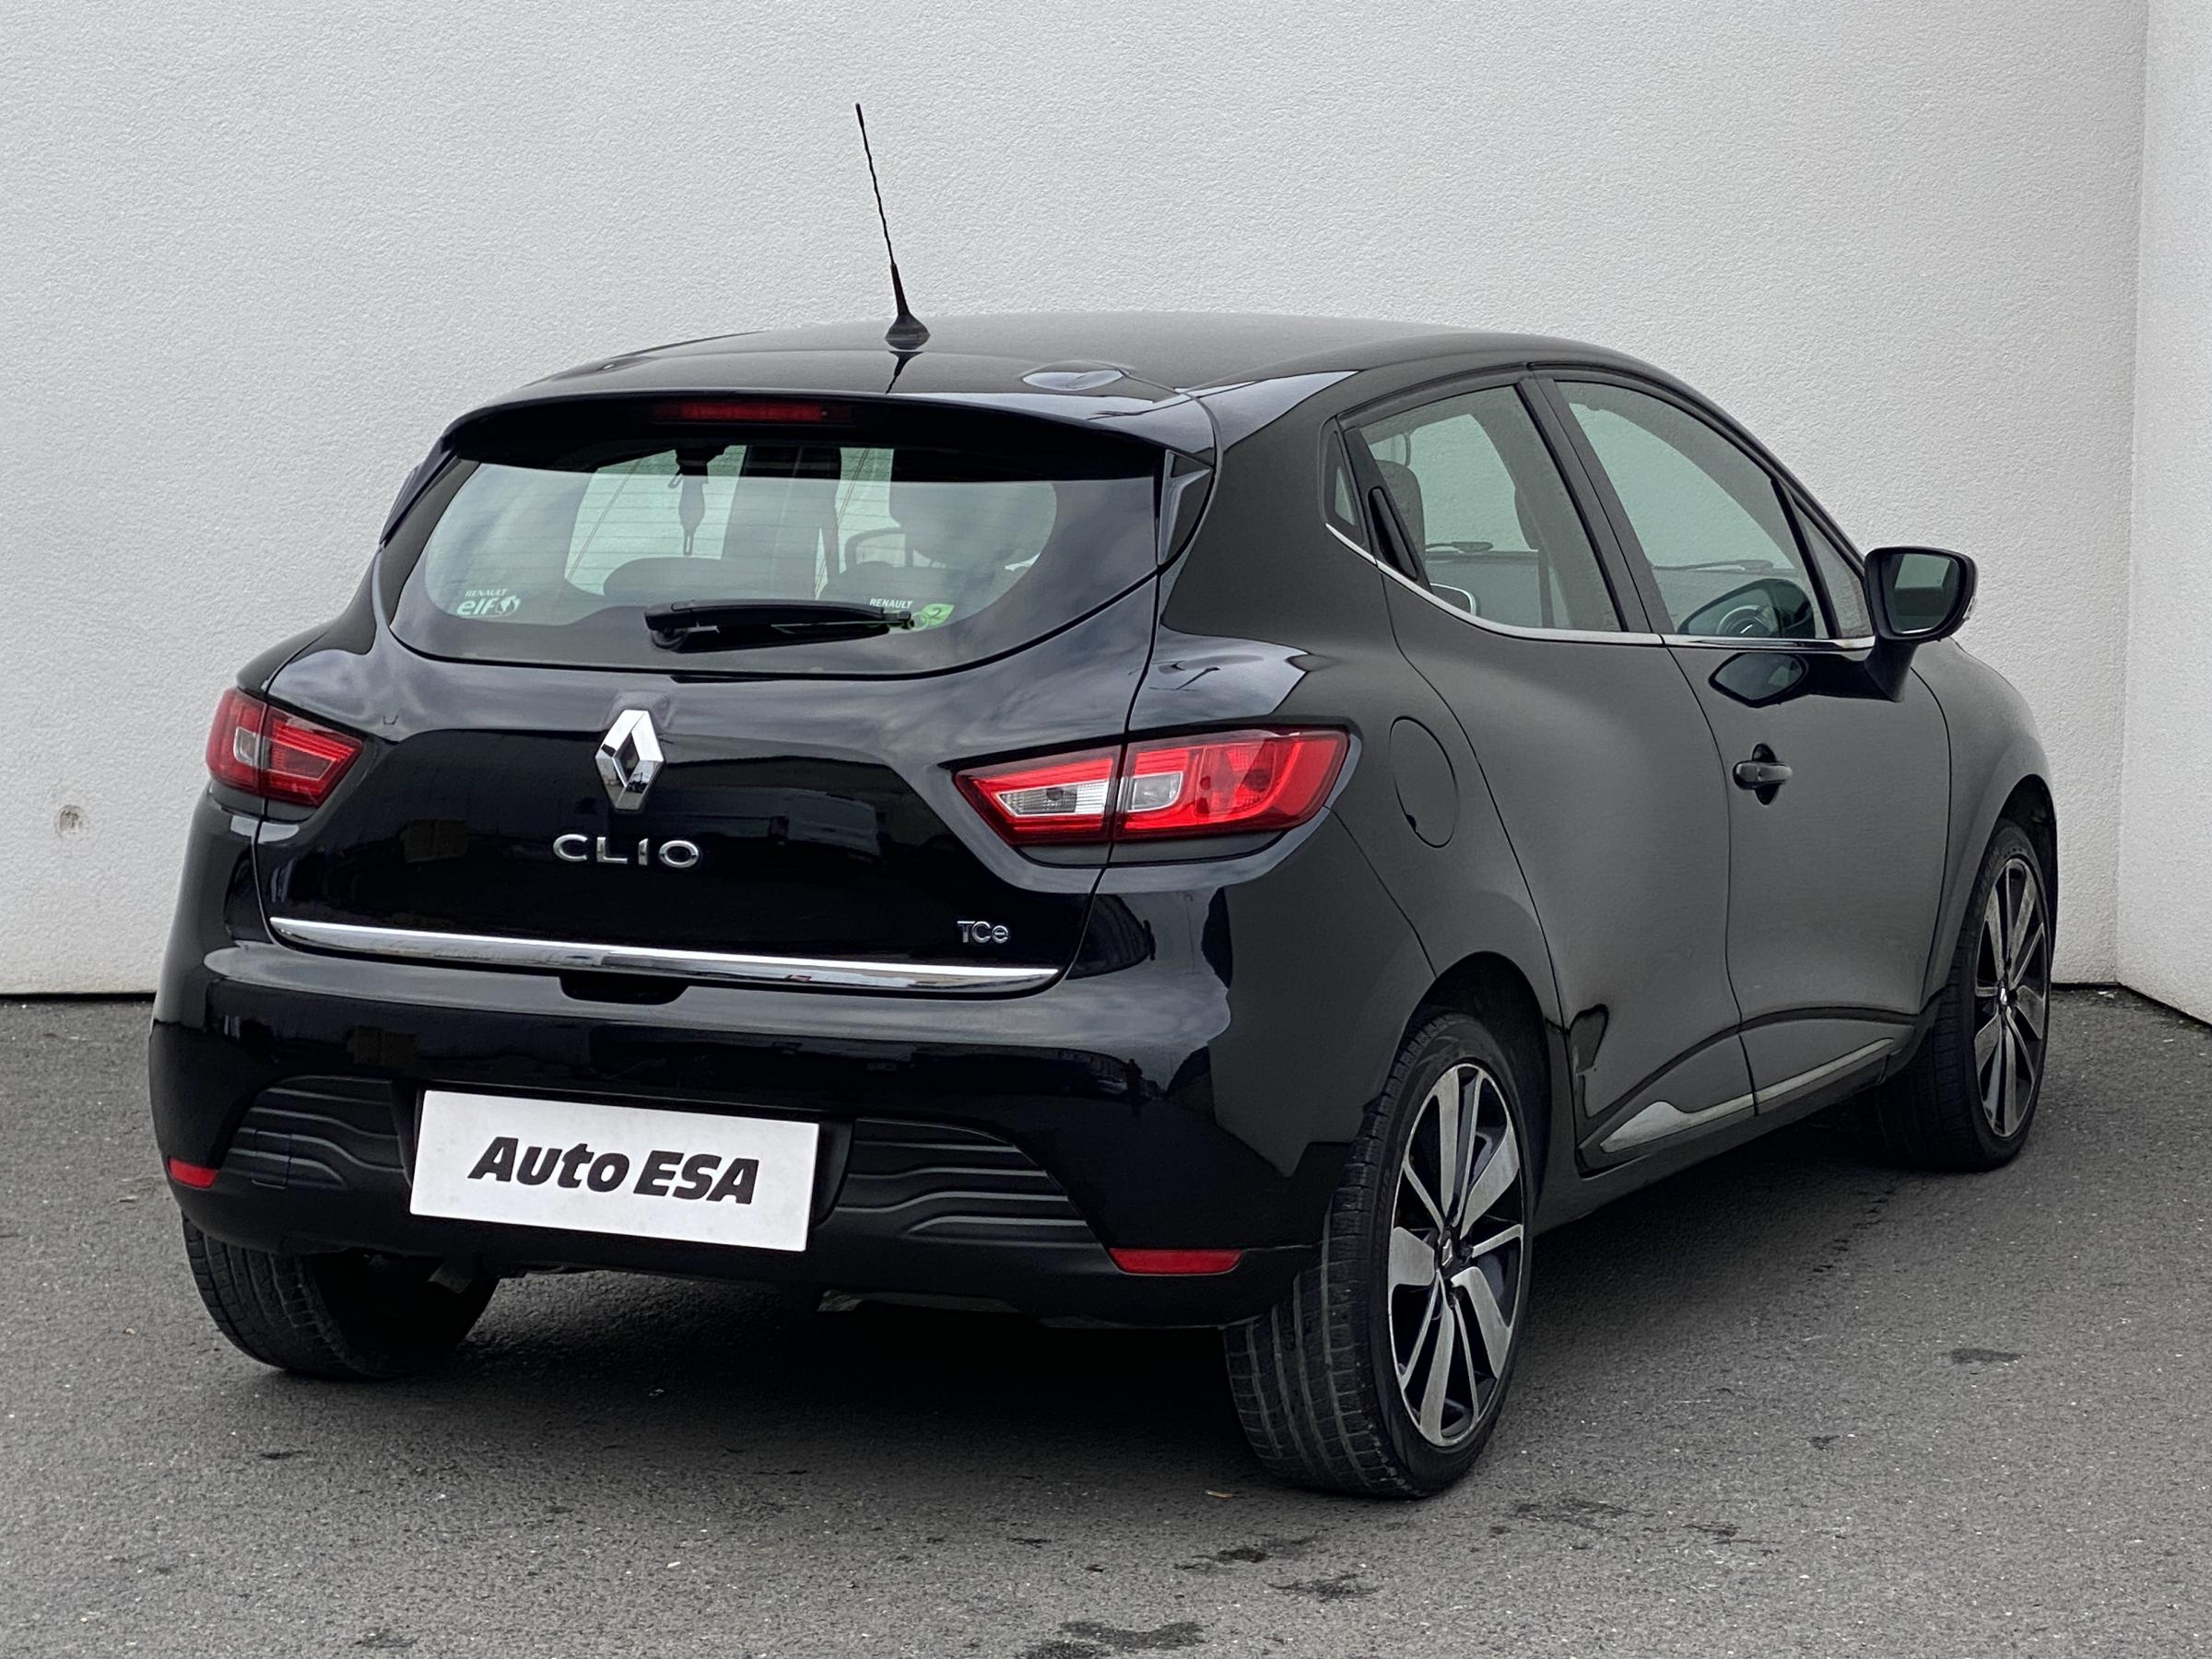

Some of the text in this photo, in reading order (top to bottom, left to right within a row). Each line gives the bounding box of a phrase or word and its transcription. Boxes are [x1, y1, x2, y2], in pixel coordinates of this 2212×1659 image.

[465, 588, 508, 597] RENAULT
[869, 598, 912, 608] RENAULT
[456, 597, 499, 616] elf
[553, 833, 700, 868] CLIO
[957, 920, 1008, 944] TCe
[466, 1136, 759, 1205] Auto ESA
